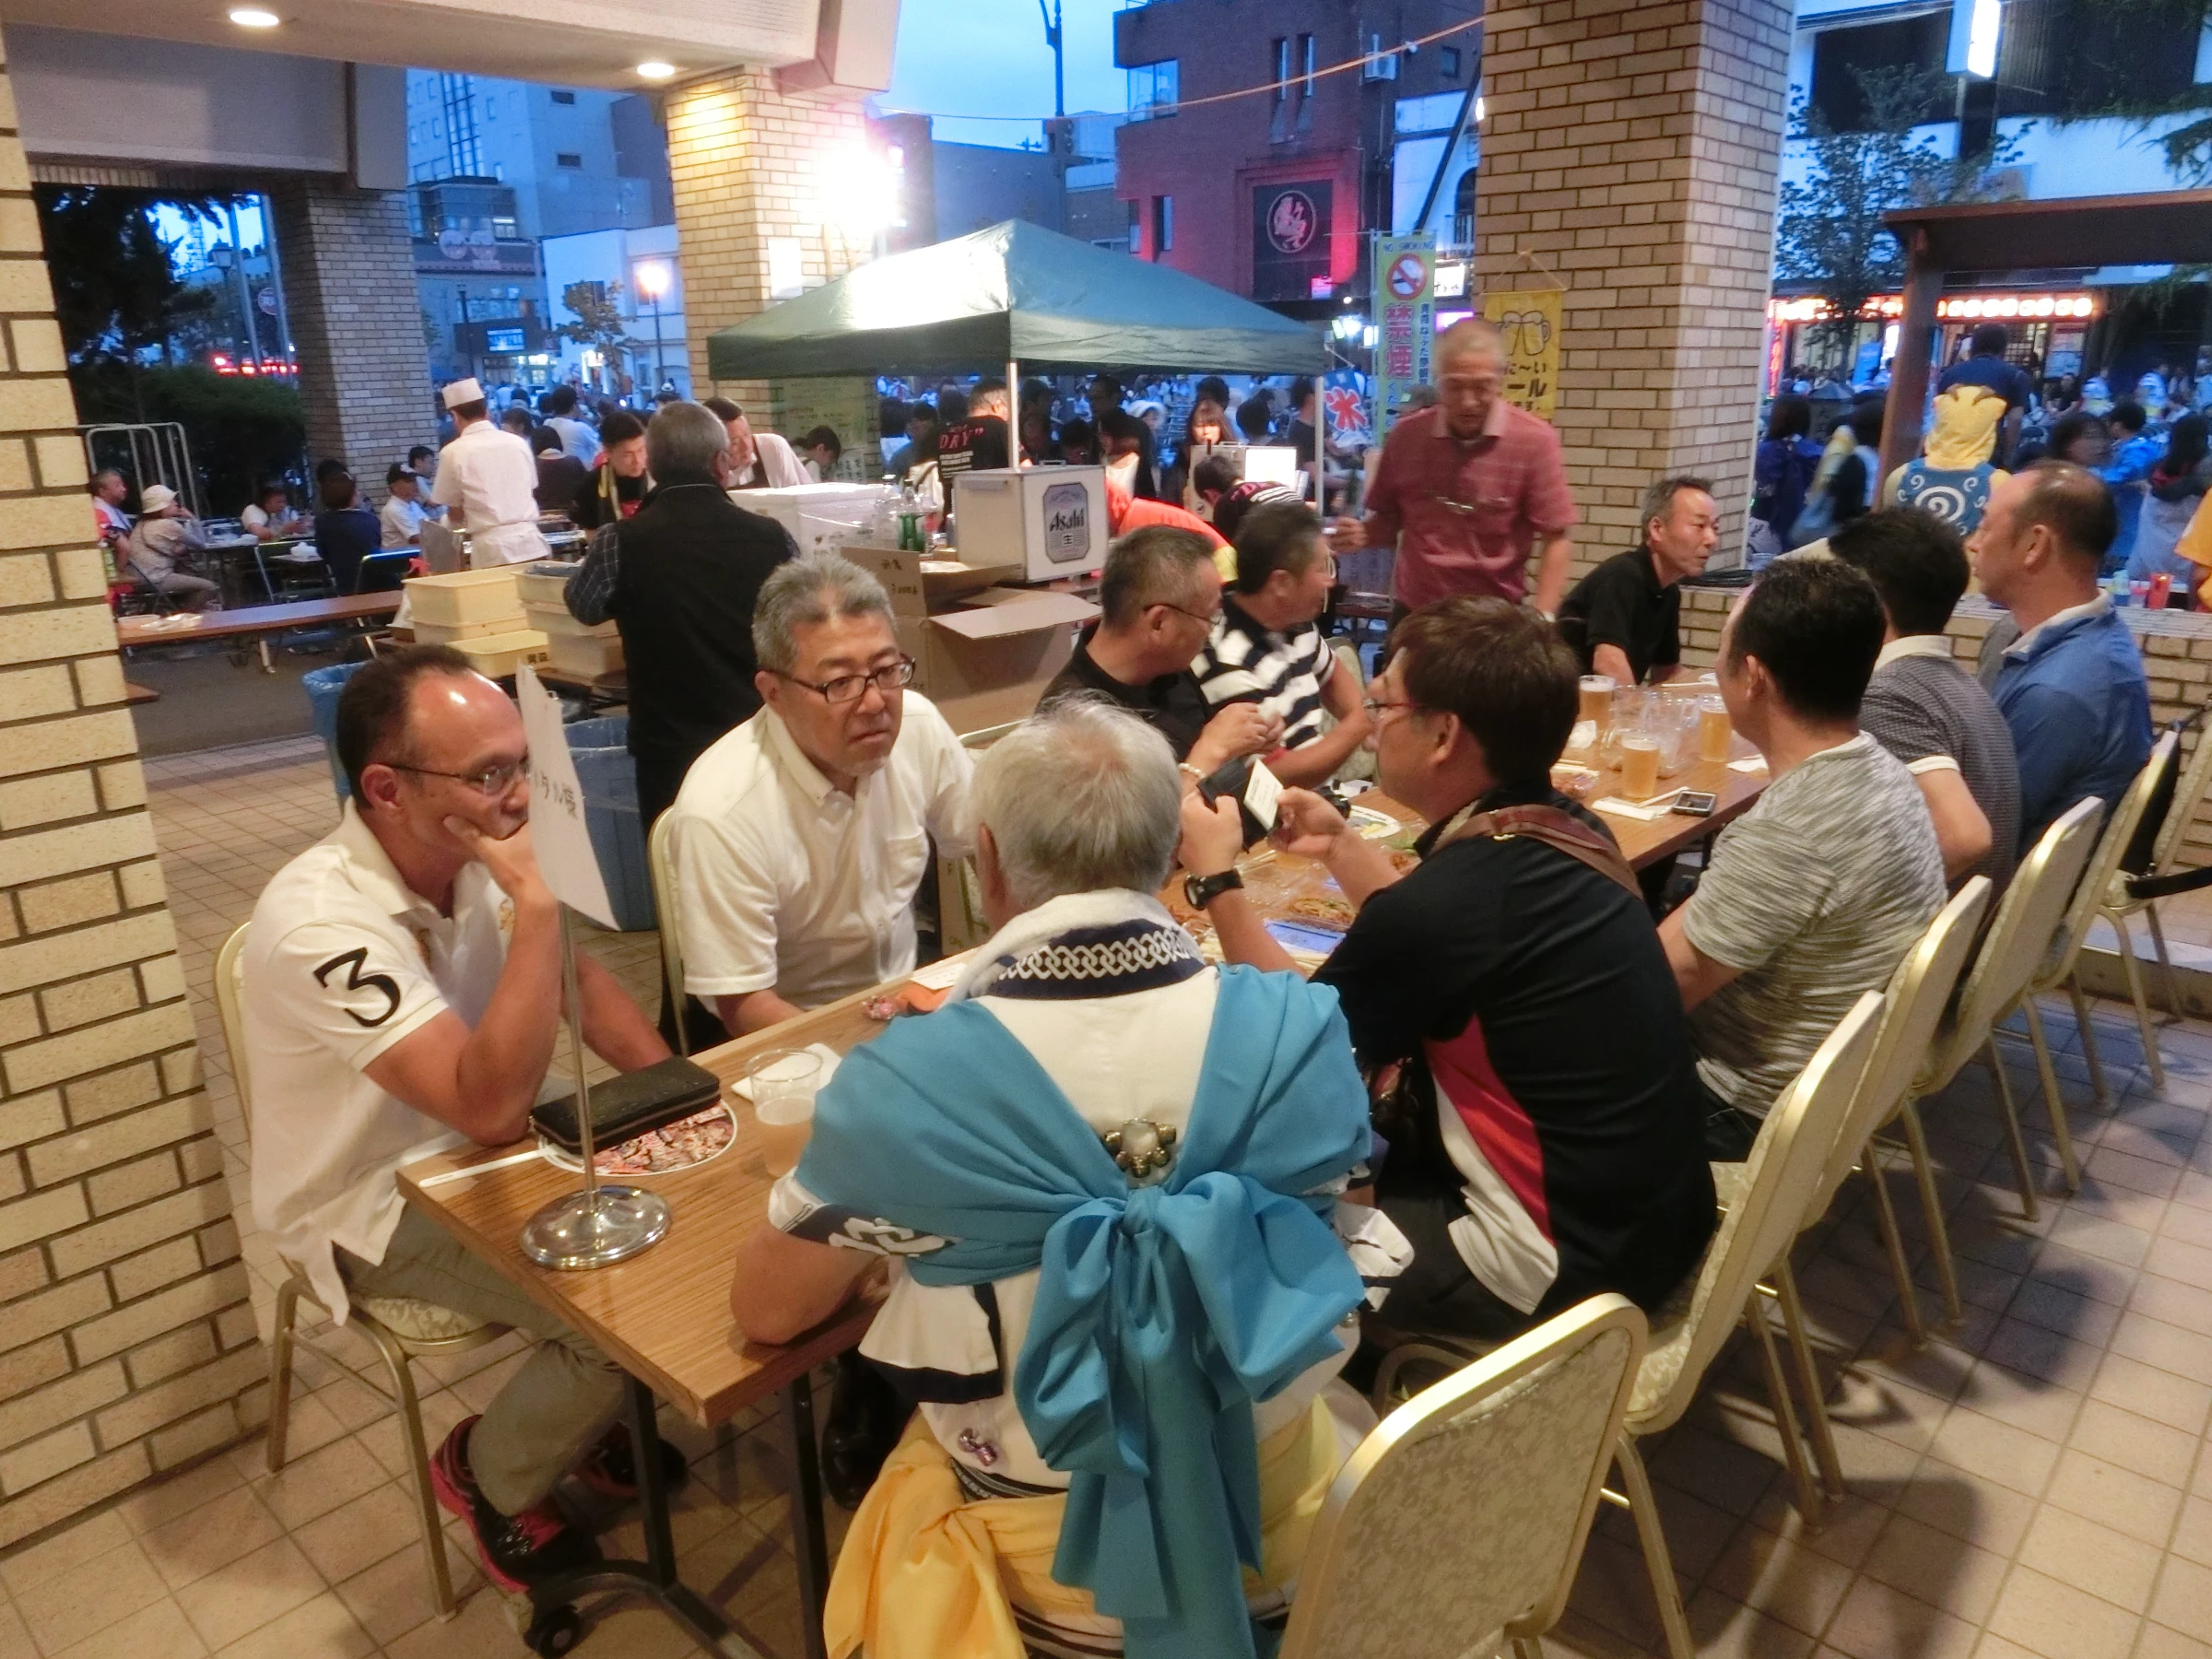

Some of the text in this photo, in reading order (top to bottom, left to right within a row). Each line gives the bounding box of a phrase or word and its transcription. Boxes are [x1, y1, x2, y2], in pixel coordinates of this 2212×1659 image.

[1383, 241, 1434, 252] NO SMOKING
[1384, 302, 1414, 379] 禁煙
[1324, 386, 1369, 432] 氷
[1049, 508, 1085, 532] Asahi
[1063, 535, 1073, 545] 生
[313, 947, 401, 1028] 3
